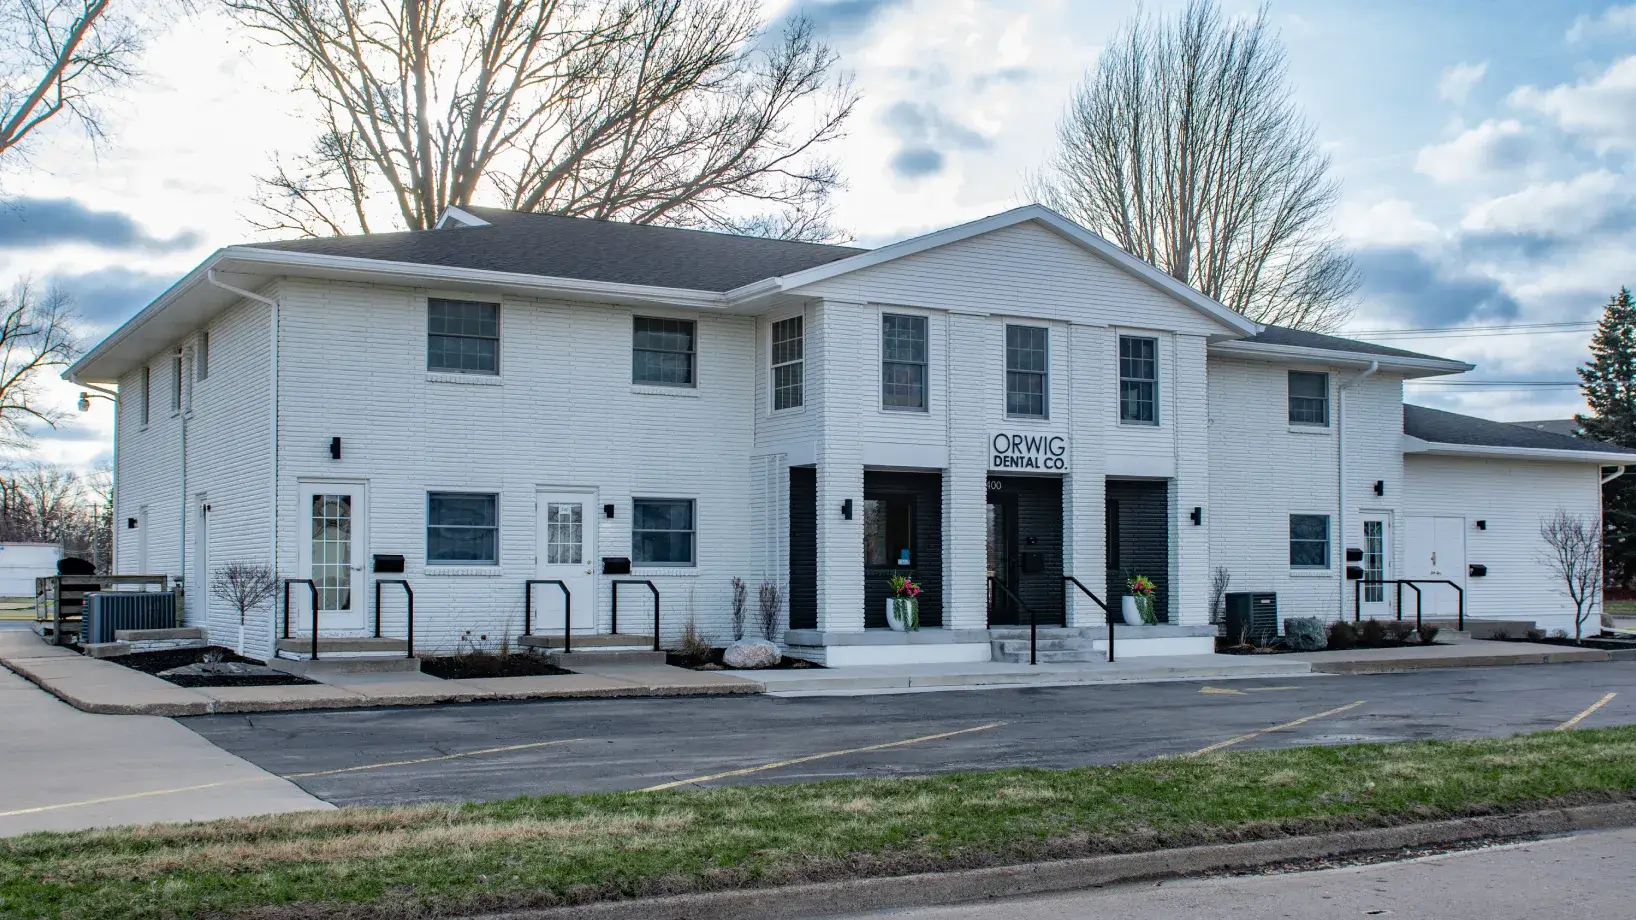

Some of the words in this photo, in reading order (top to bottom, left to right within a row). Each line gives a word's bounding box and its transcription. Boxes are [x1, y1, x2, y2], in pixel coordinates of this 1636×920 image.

[993, 433, 1066, 456] ORWIG
[993, 455, 1040, 468] DENTAL
[1043, 457, 1068, 470] CO.
